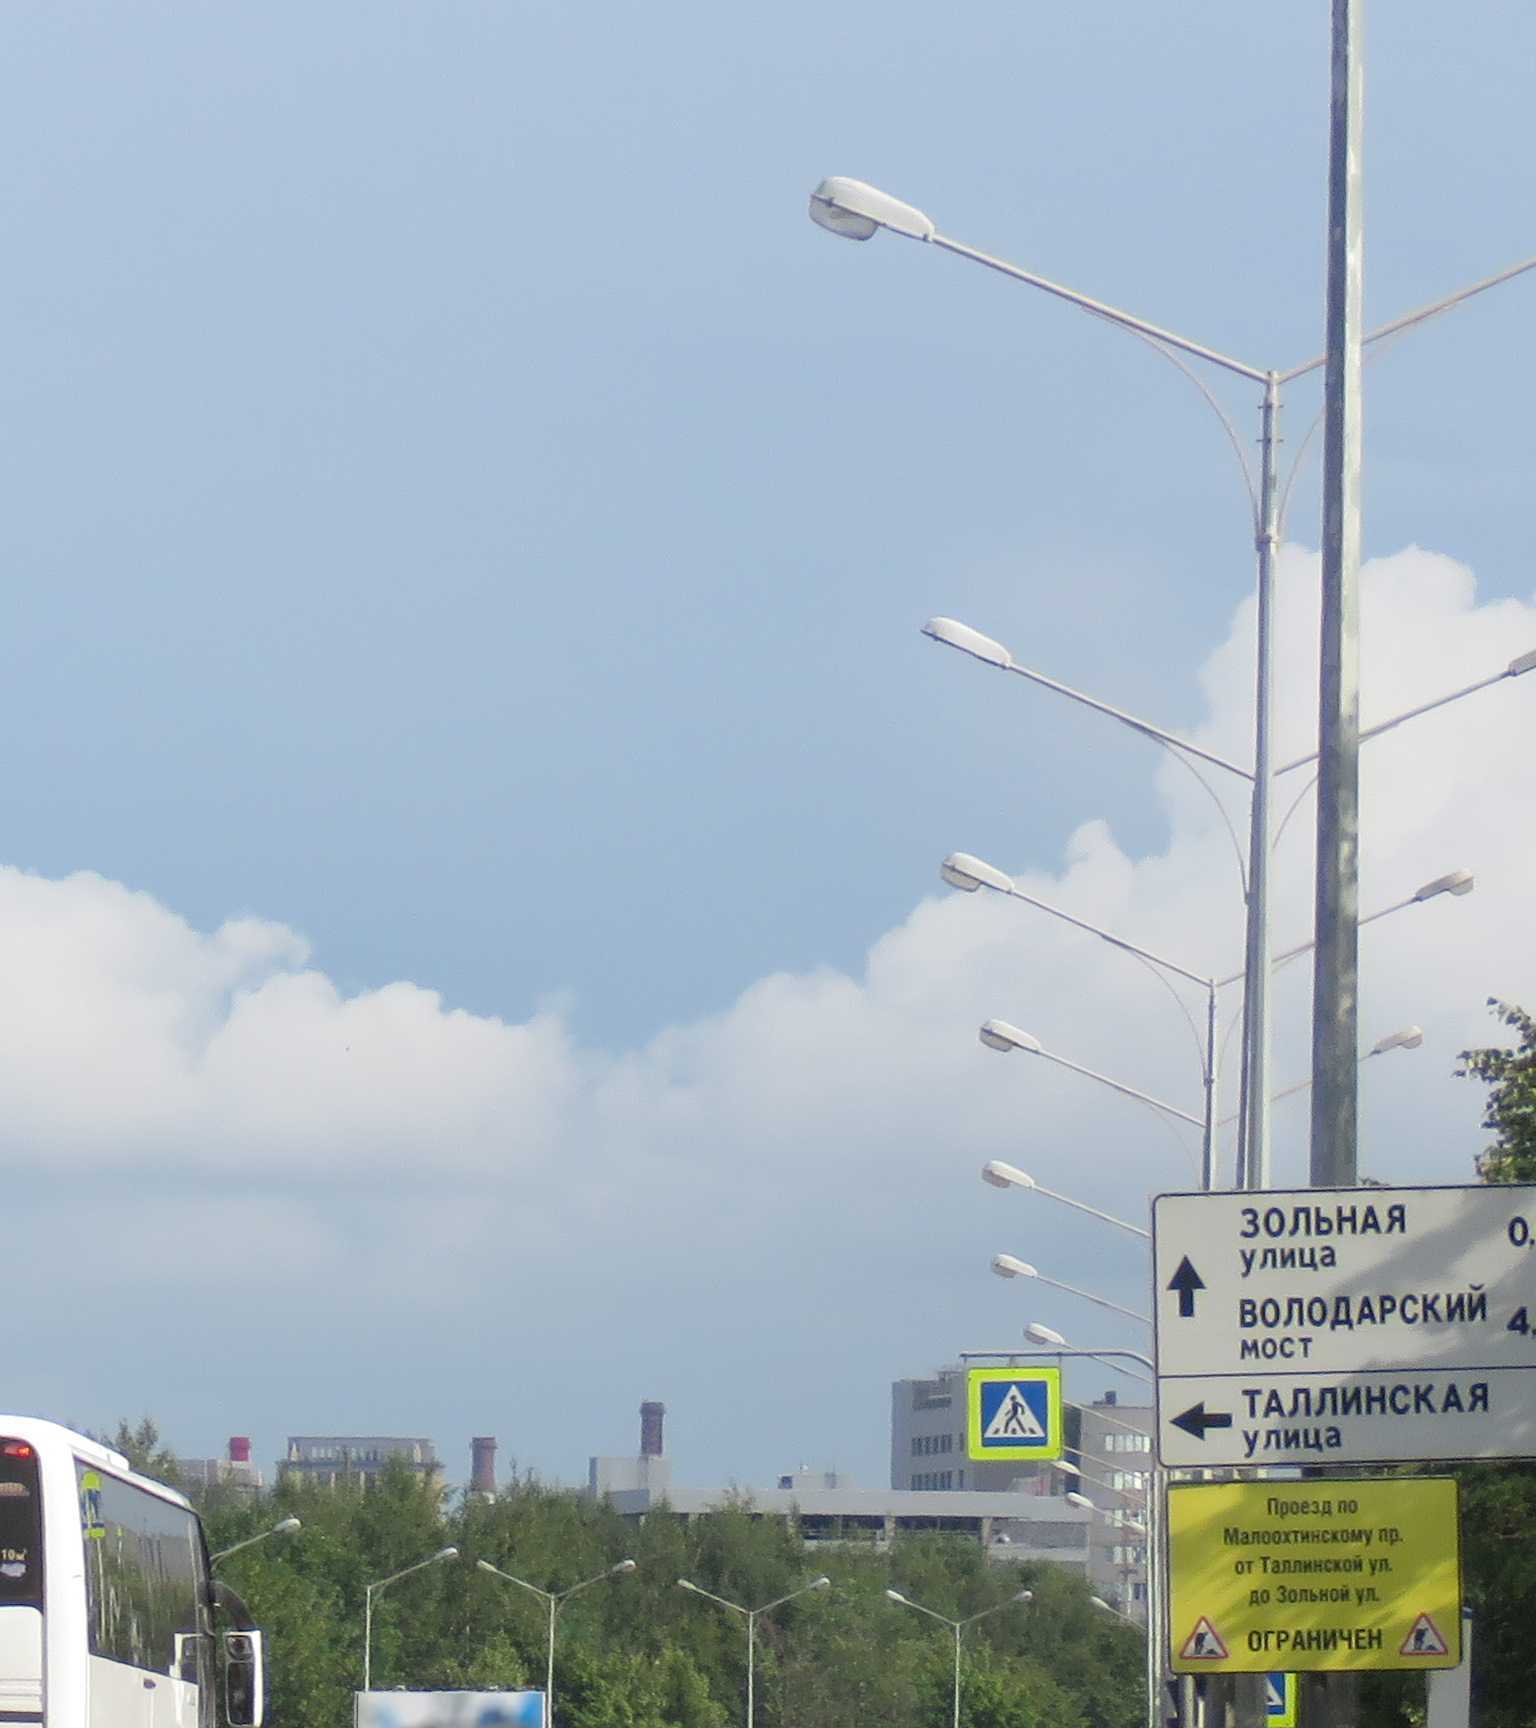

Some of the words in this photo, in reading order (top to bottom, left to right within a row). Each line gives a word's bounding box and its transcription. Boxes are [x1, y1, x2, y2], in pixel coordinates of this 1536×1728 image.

[1239, 1204, 1407, 1238] ЗОЛЬНАЯ
[1240, 1245, 1337, 1277] улица
[1239, 1284, 1488, 1331] ВОЛОДАРСКИЙ
[1242, 1383, 1489, 1419] ТАЛЛИНСКАЯ
[1243, 1426, 1342, 1458] улица
[1267, 1498, 1332, 1519] Проезд
[1337, 1500, 1358, 1514] по
[1224, 1528, 1372, 1549] Малоохтинскому
[1379, 1531, 1404, 1547] пр.
[1235, 1559, 1254, 1575] от
[1260, 1554, 1363, 1575] Таллинской
[1369, 1558, 1393, 1577] ул.
[1249, 1588, 1271, 1607] до
[1276, 1584, 1349, 1603] Зольной
[1354, 1588, 1380, 1606] ул.
[1247, 1628, 1383, 1651] ОГРАНИЧЕН
